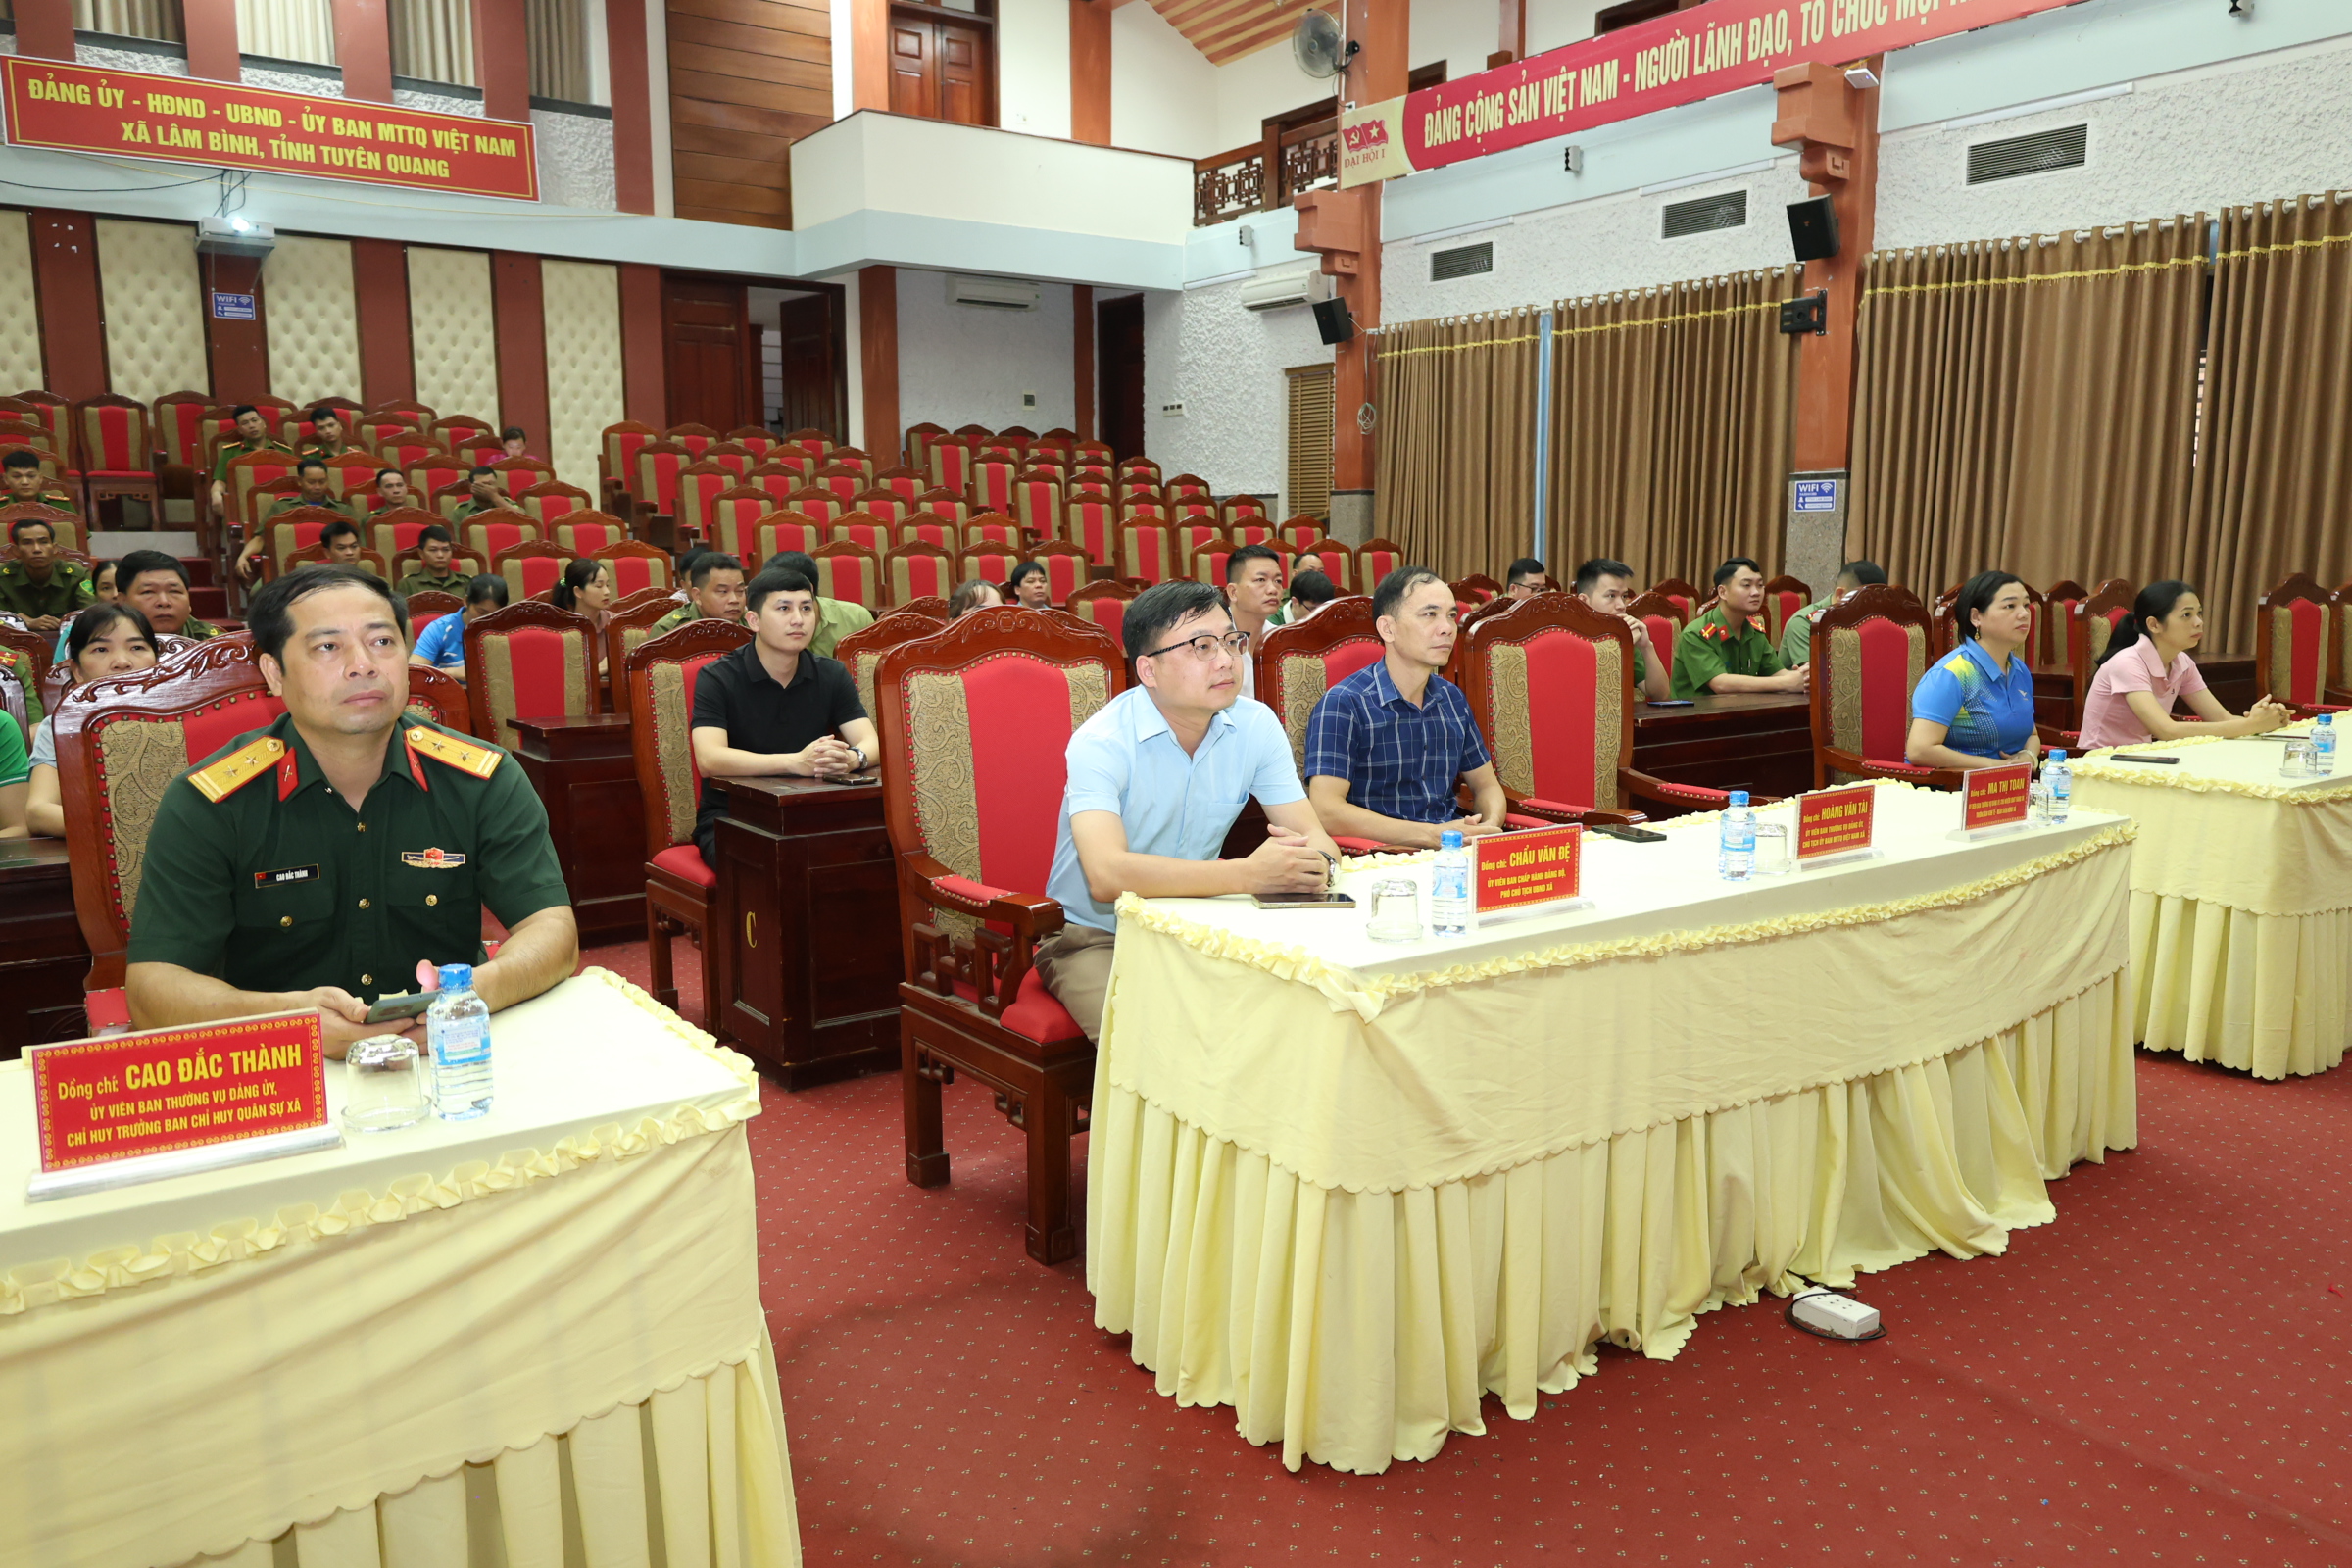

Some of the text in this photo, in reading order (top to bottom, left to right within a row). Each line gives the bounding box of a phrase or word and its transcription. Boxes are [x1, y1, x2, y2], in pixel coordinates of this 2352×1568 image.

[1424, 94, 1461, 148] ĐẢNG
[1465, 90, 1504, 143] CỘNG
[1508, 70, 1540, 126] SẢN
[1544, 66, 1577, 122] VIỆT
[1580, 59, 1619, 107] NAM
[1635, 29, 1689, 92] NGƯỜI
[1693, 22, 1742, 76] LÃNH
[1747, 9, 1792, 67] ĐẠO,
[28, 73, 91, 105] ĐẢNG
[98, 79, 124, 109] ỦY
[147, 93, 206, 119] HĐND
[225, 103, 282, 128] UBND
[302, 106, 326, 133] ỦY
[332, 118, 372, 140] BAN
[377, 123, 428, 149] MTTQ
[432, 128, 469, 154] VIỆT
[474, 135, 516, 157] NAM
[121, 120, 450, 178] XÃ LÂM BÌNH, TỈNH TUYÊN QUANG
[1362, 149, 1379, 164] HỘI
[1798, 483, 1819, 492] WIFI
[1844, 801, 1857, 816] VĂN
[1538, 845, 1556, 863] VĂN
[1558, 842, 1571, 863] ĐỆ
[125, 1060, 172, 1090] CAO
[177, 1047, 223, 1083] ĐẮC
[229, 1043, 302, 1075] THÀNH
[90, 1078, 278, 1121] ỦY VIÊN BAN THƯỜNG VỤ ĐẢNG ỦY,
[67, 1126, 87, 1148] CHỈ
[89, 1127, 113, 1145] HUY
[164, 1116, 188, 1132] BAN
[191, 1109, 210, 1128] CHỈ
[213, 1109, 234, 1125] HUY
[236, 1103, 267, 1122] QUÂN
[270, 1101, 285, 1117] SỰ
[287, 1097, 302, 1113] XÃ
